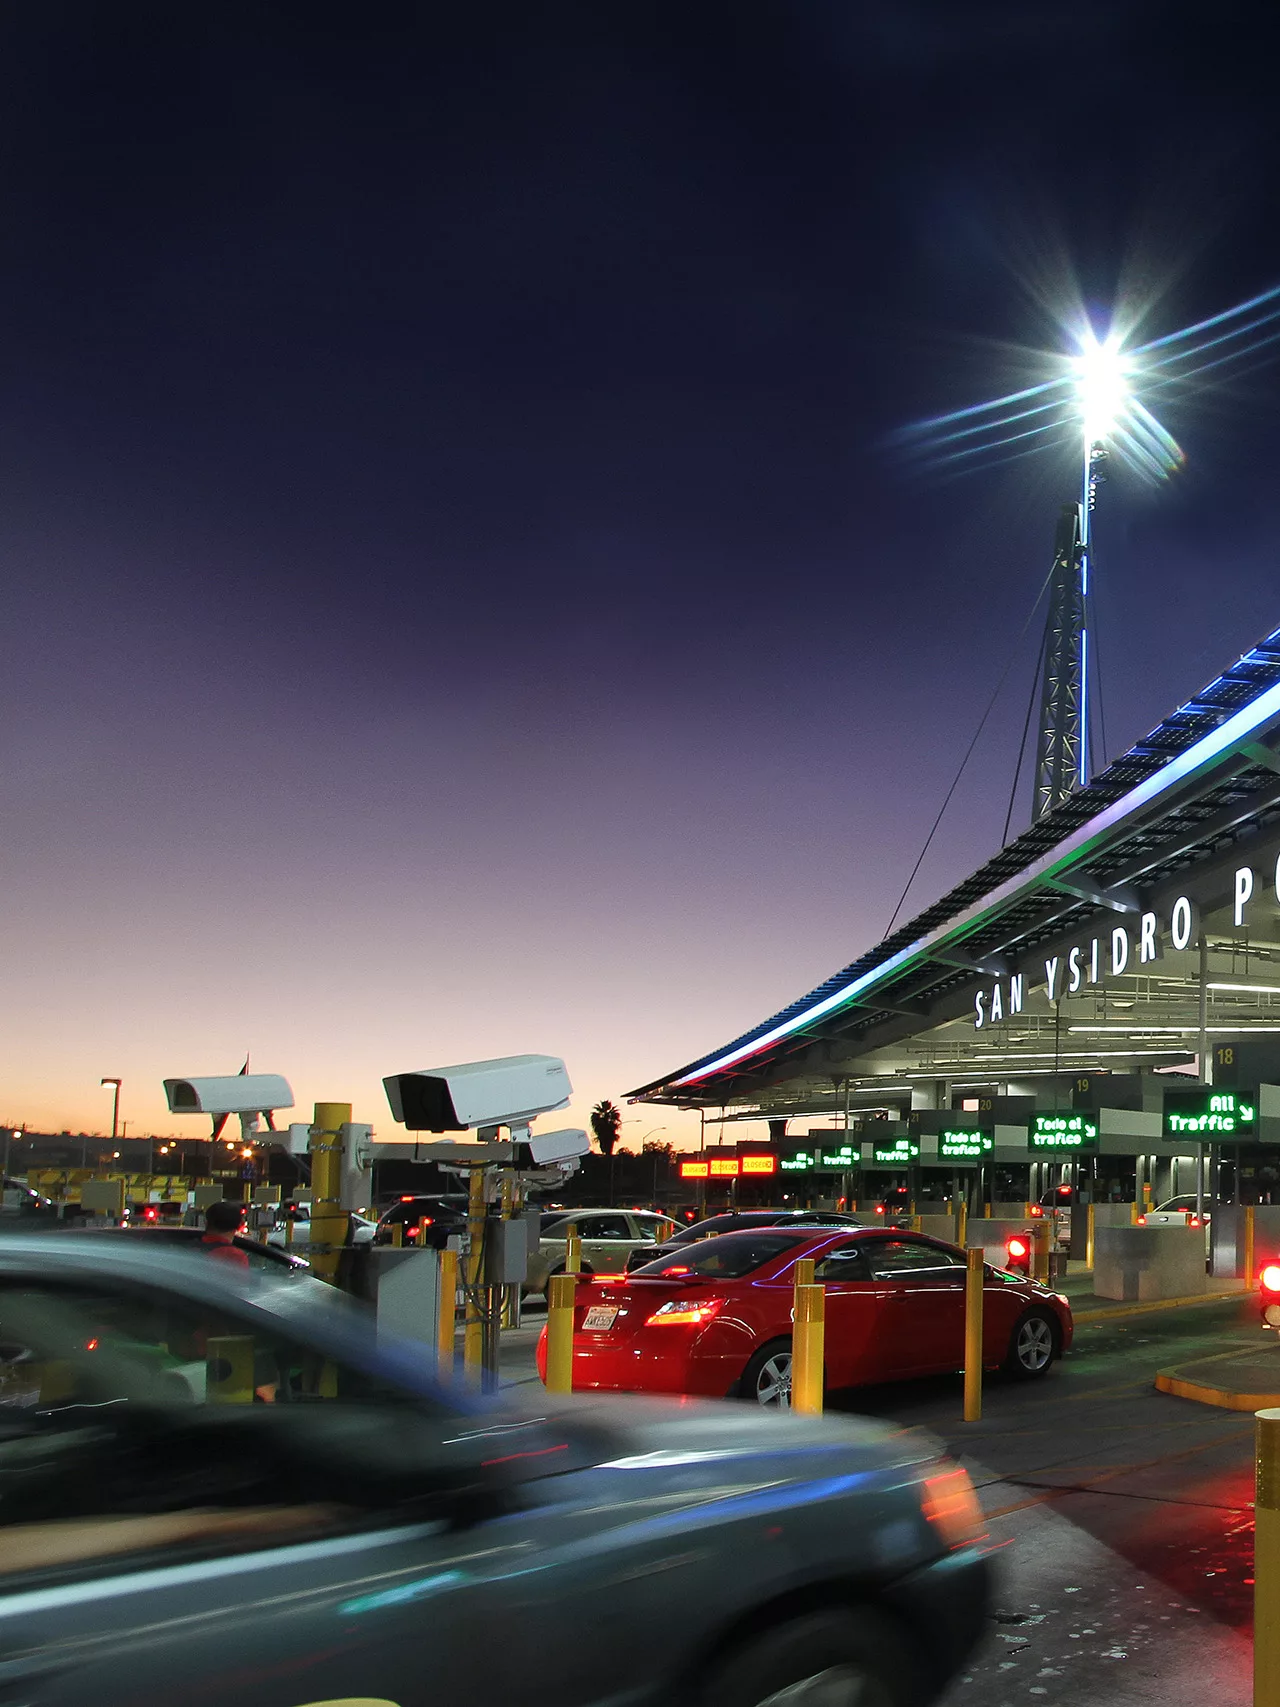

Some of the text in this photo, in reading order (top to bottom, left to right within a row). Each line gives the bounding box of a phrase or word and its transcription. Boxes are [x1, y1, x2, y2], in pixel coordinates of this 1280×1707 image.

[974, 971, 1024, 1029] SAN
[1044, 895, 1192, 1000] YSIDRO
[1217, 1048, 1233, 1065] 18
[1076, 1078, 1089, 1093] 19
[980, 1099, 992, 1111] 20
[1210, 1095, 1235, 1112] All
[911, 1112, 920, 1123] 21
[1036, 1116, 1082, 1131] Todo el
[1169, 1114, 1235, 1131] Traffic
[1033, 1132, 1082, 1146] trafico
[942, 1144, 981, 1156] trafico
